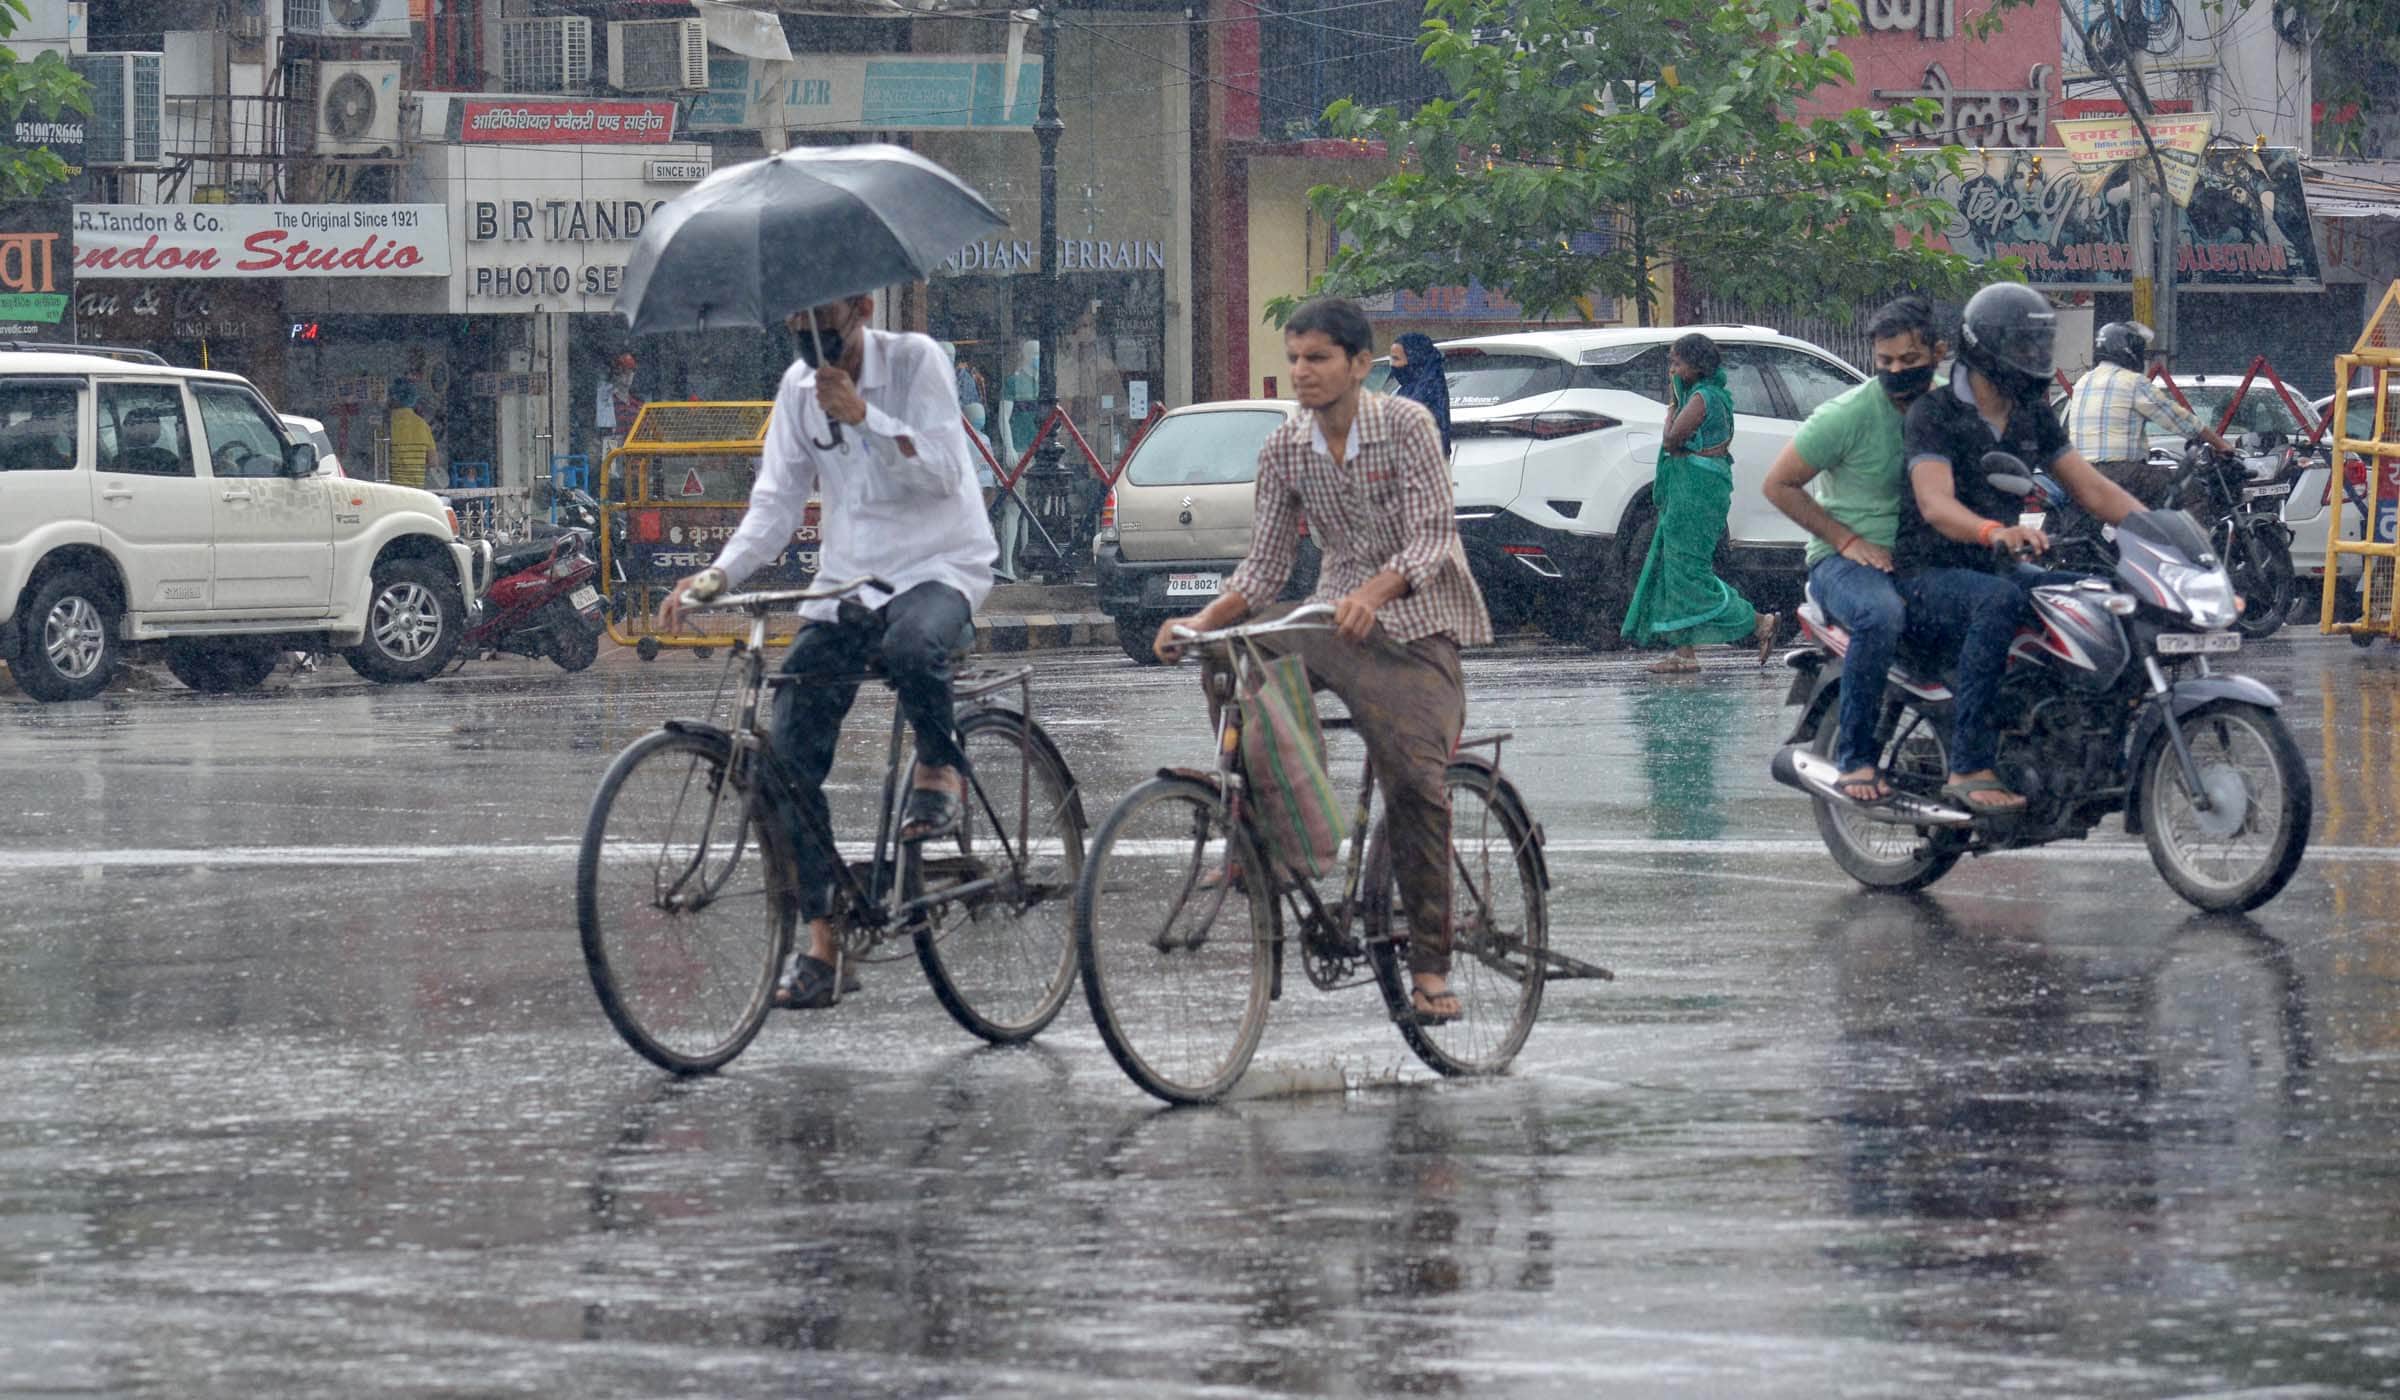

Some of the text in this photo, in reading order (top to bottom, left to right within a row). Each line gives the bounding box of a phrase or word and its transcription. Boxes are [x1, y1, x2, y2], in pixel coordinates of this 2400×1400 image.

[15, 122, 84, 144] 9519078666
[656, 166, 706, 177] SINCE 1921
[174, 212, 187, 231] &
[193, 213, 224, 232] Co.
[274, 211, 419, 232] The Original Since 1921
[546, 200, 668, 240] TAND
[236, 229, 424, 271] Studio
[1057, 239, 1164, 269] ERRAIN
[2176, 243, 2288, 272] OLLECTION
[477, 266, 628, 295] PHOTO SE
